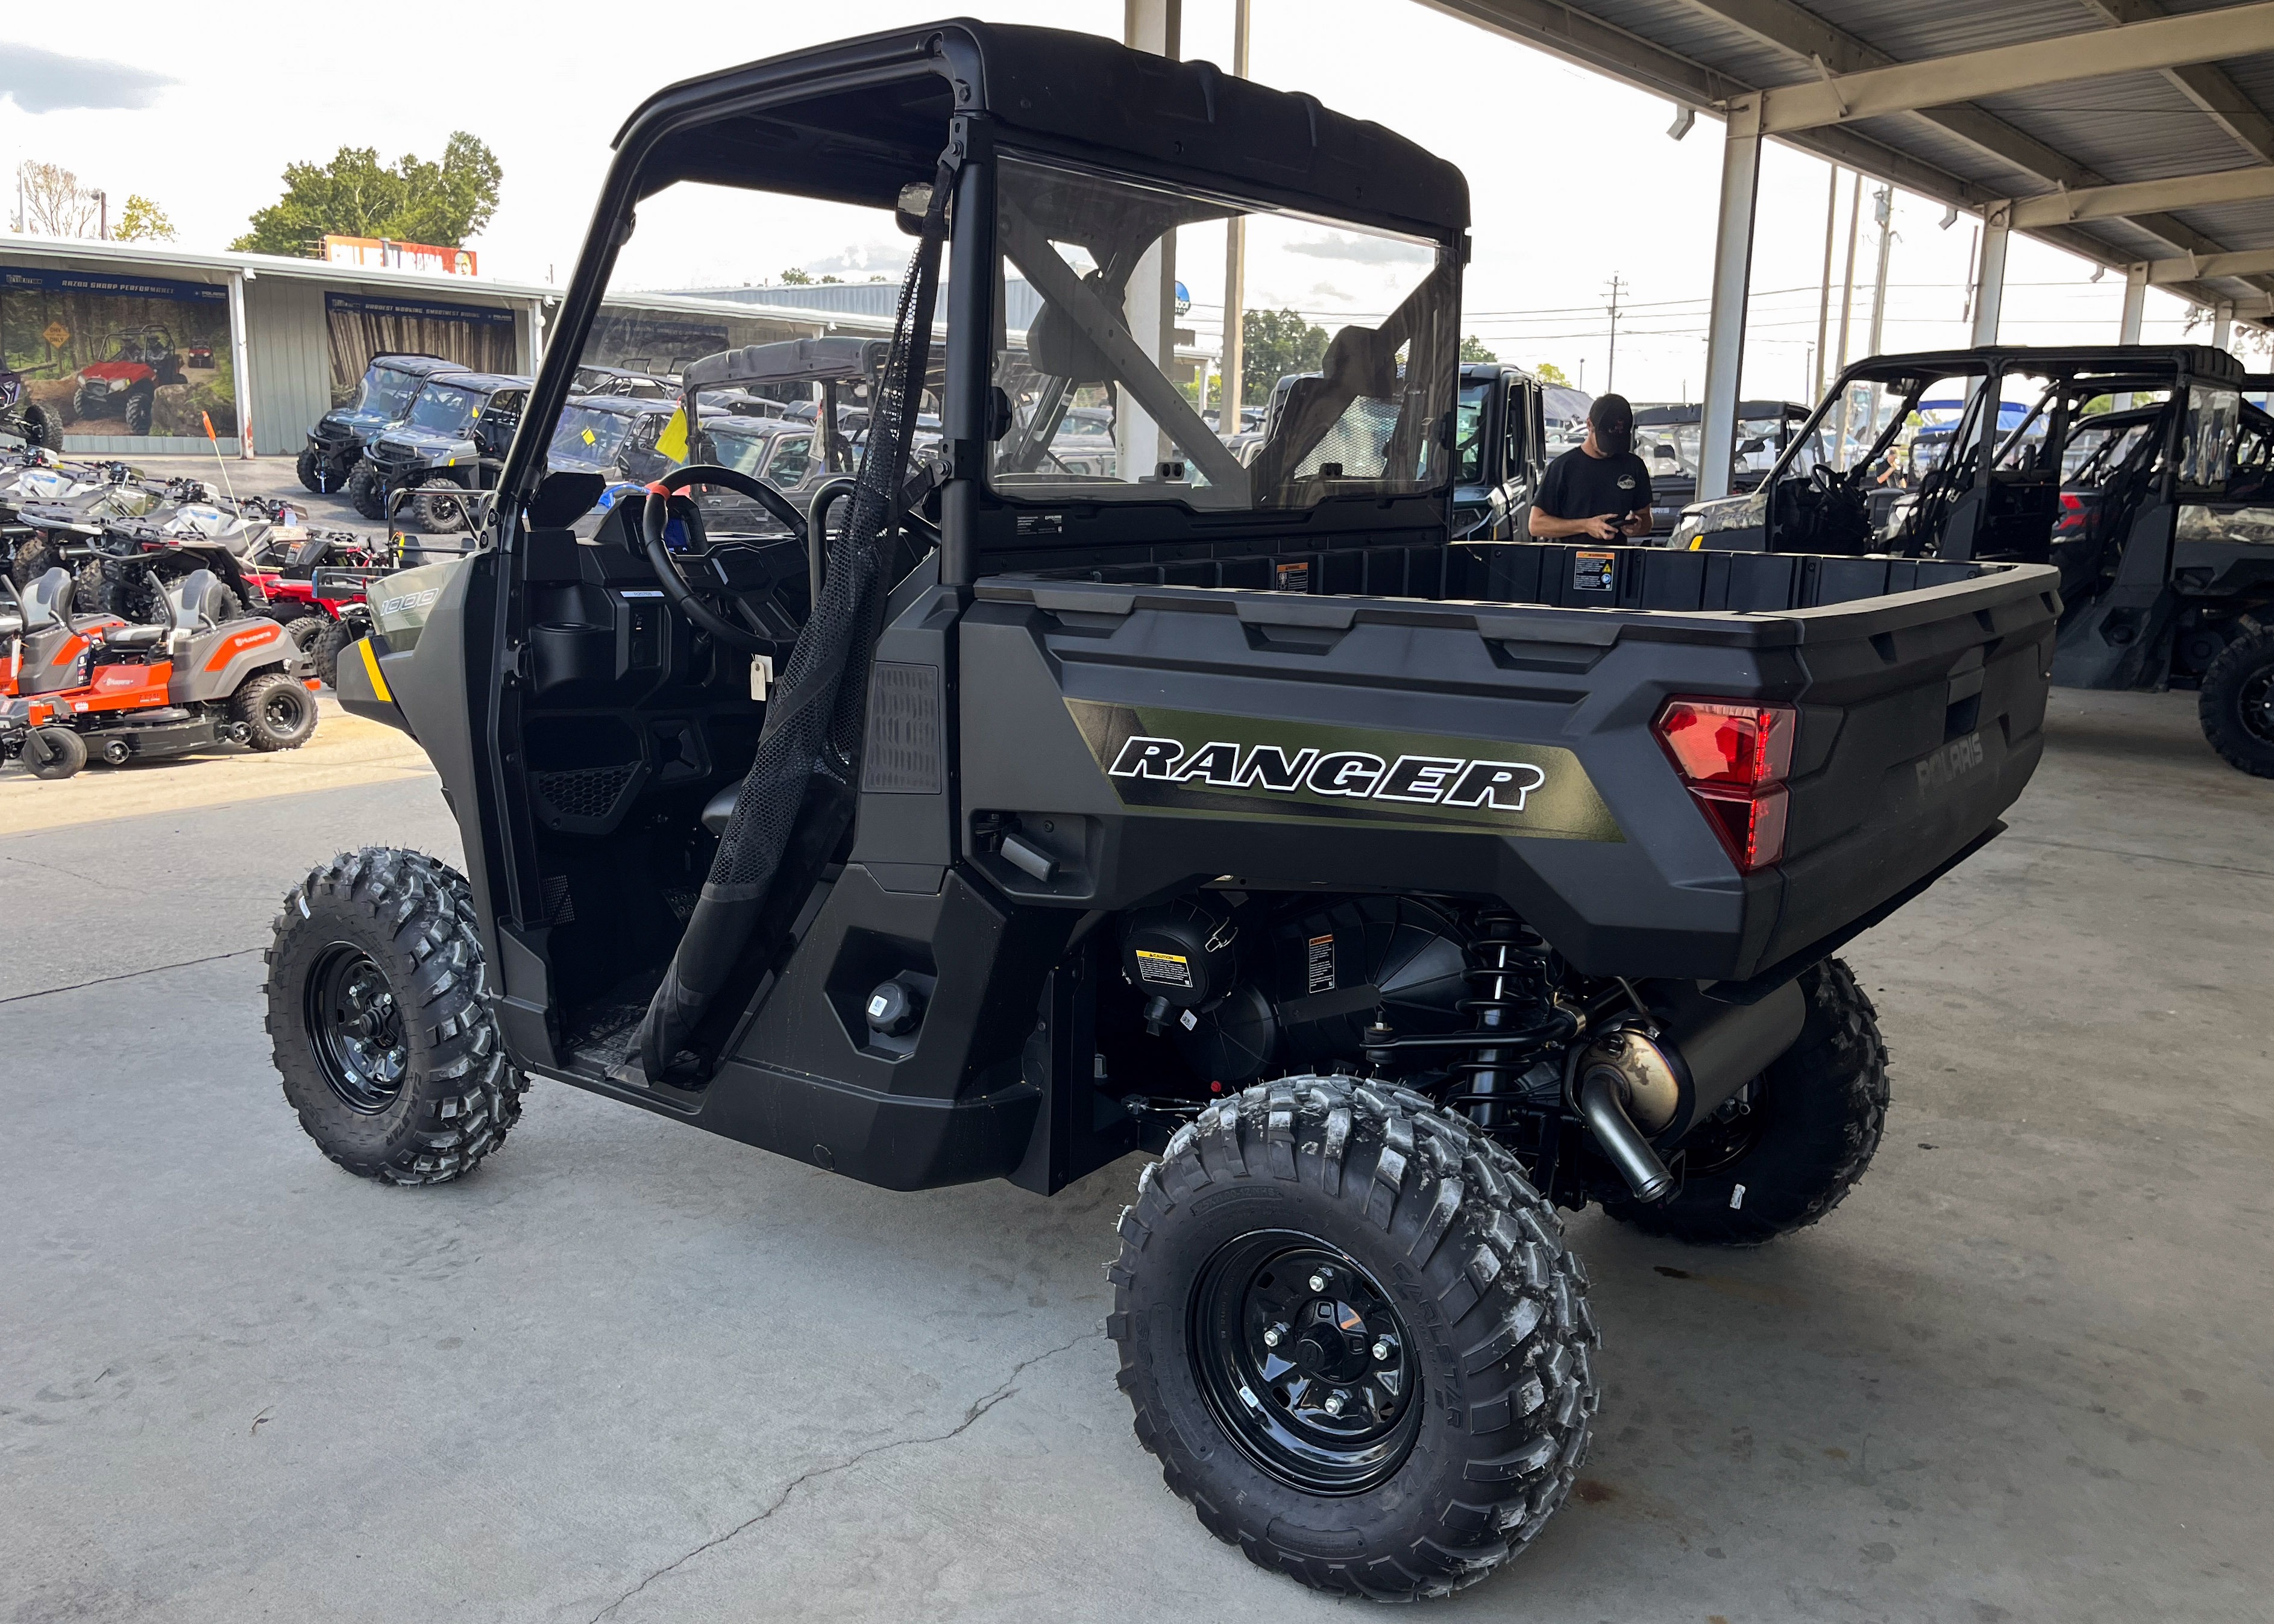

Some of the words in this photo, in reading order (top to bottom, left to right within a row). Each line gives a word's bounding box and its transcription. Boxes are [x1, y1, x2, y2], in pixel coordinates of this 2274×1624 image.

[62, 280, 88, 288] RAZOR
[380, 588, 439, 617] 1000
[1107, 735, 1547, 812] RANGER
[1915, 732, 1983, 800] POLARIS
[1391, 1261, 1463, 1431] CARLSTAR
